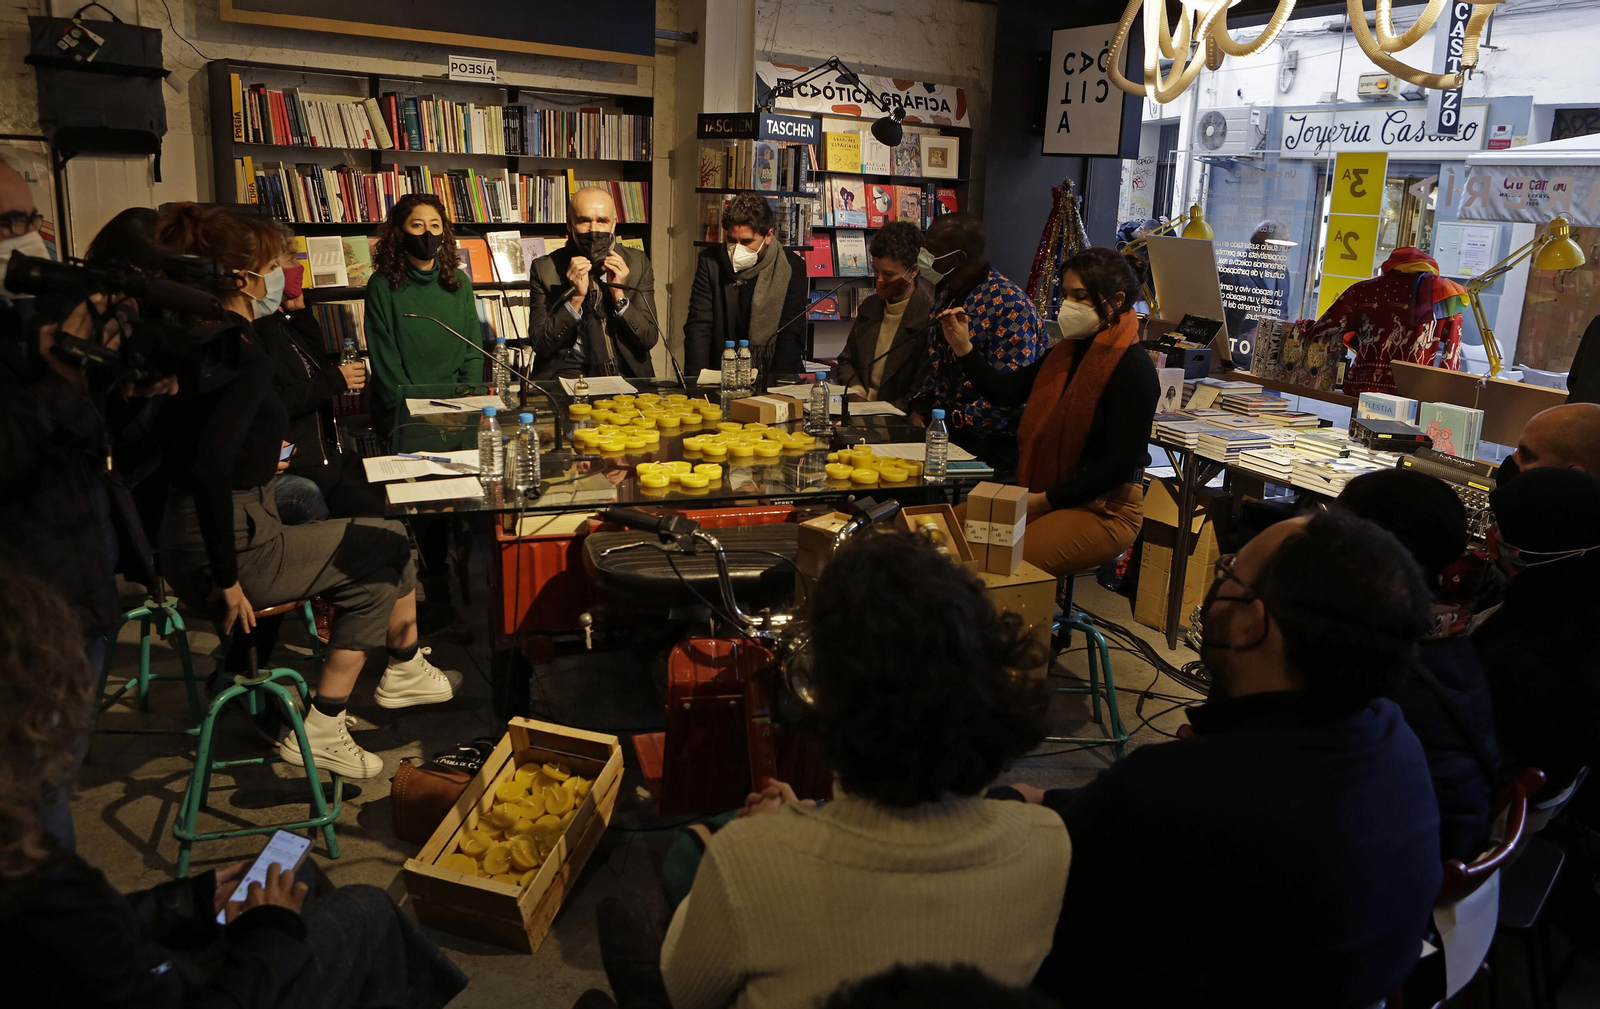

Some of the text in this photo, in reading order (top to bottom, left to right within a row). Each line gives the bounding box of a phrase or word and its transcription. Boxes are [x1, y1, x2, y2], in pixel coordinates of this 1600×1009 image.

[451, 61, 495, 76] POESÍA
[1441, 2, 1469, 127] CASTZO
[766, 119, 814, 138] TASCHEN
[1285, 110, 1479, 156] Joyeria Caso
[1360, 400, 1393, 414] CELESTIA
